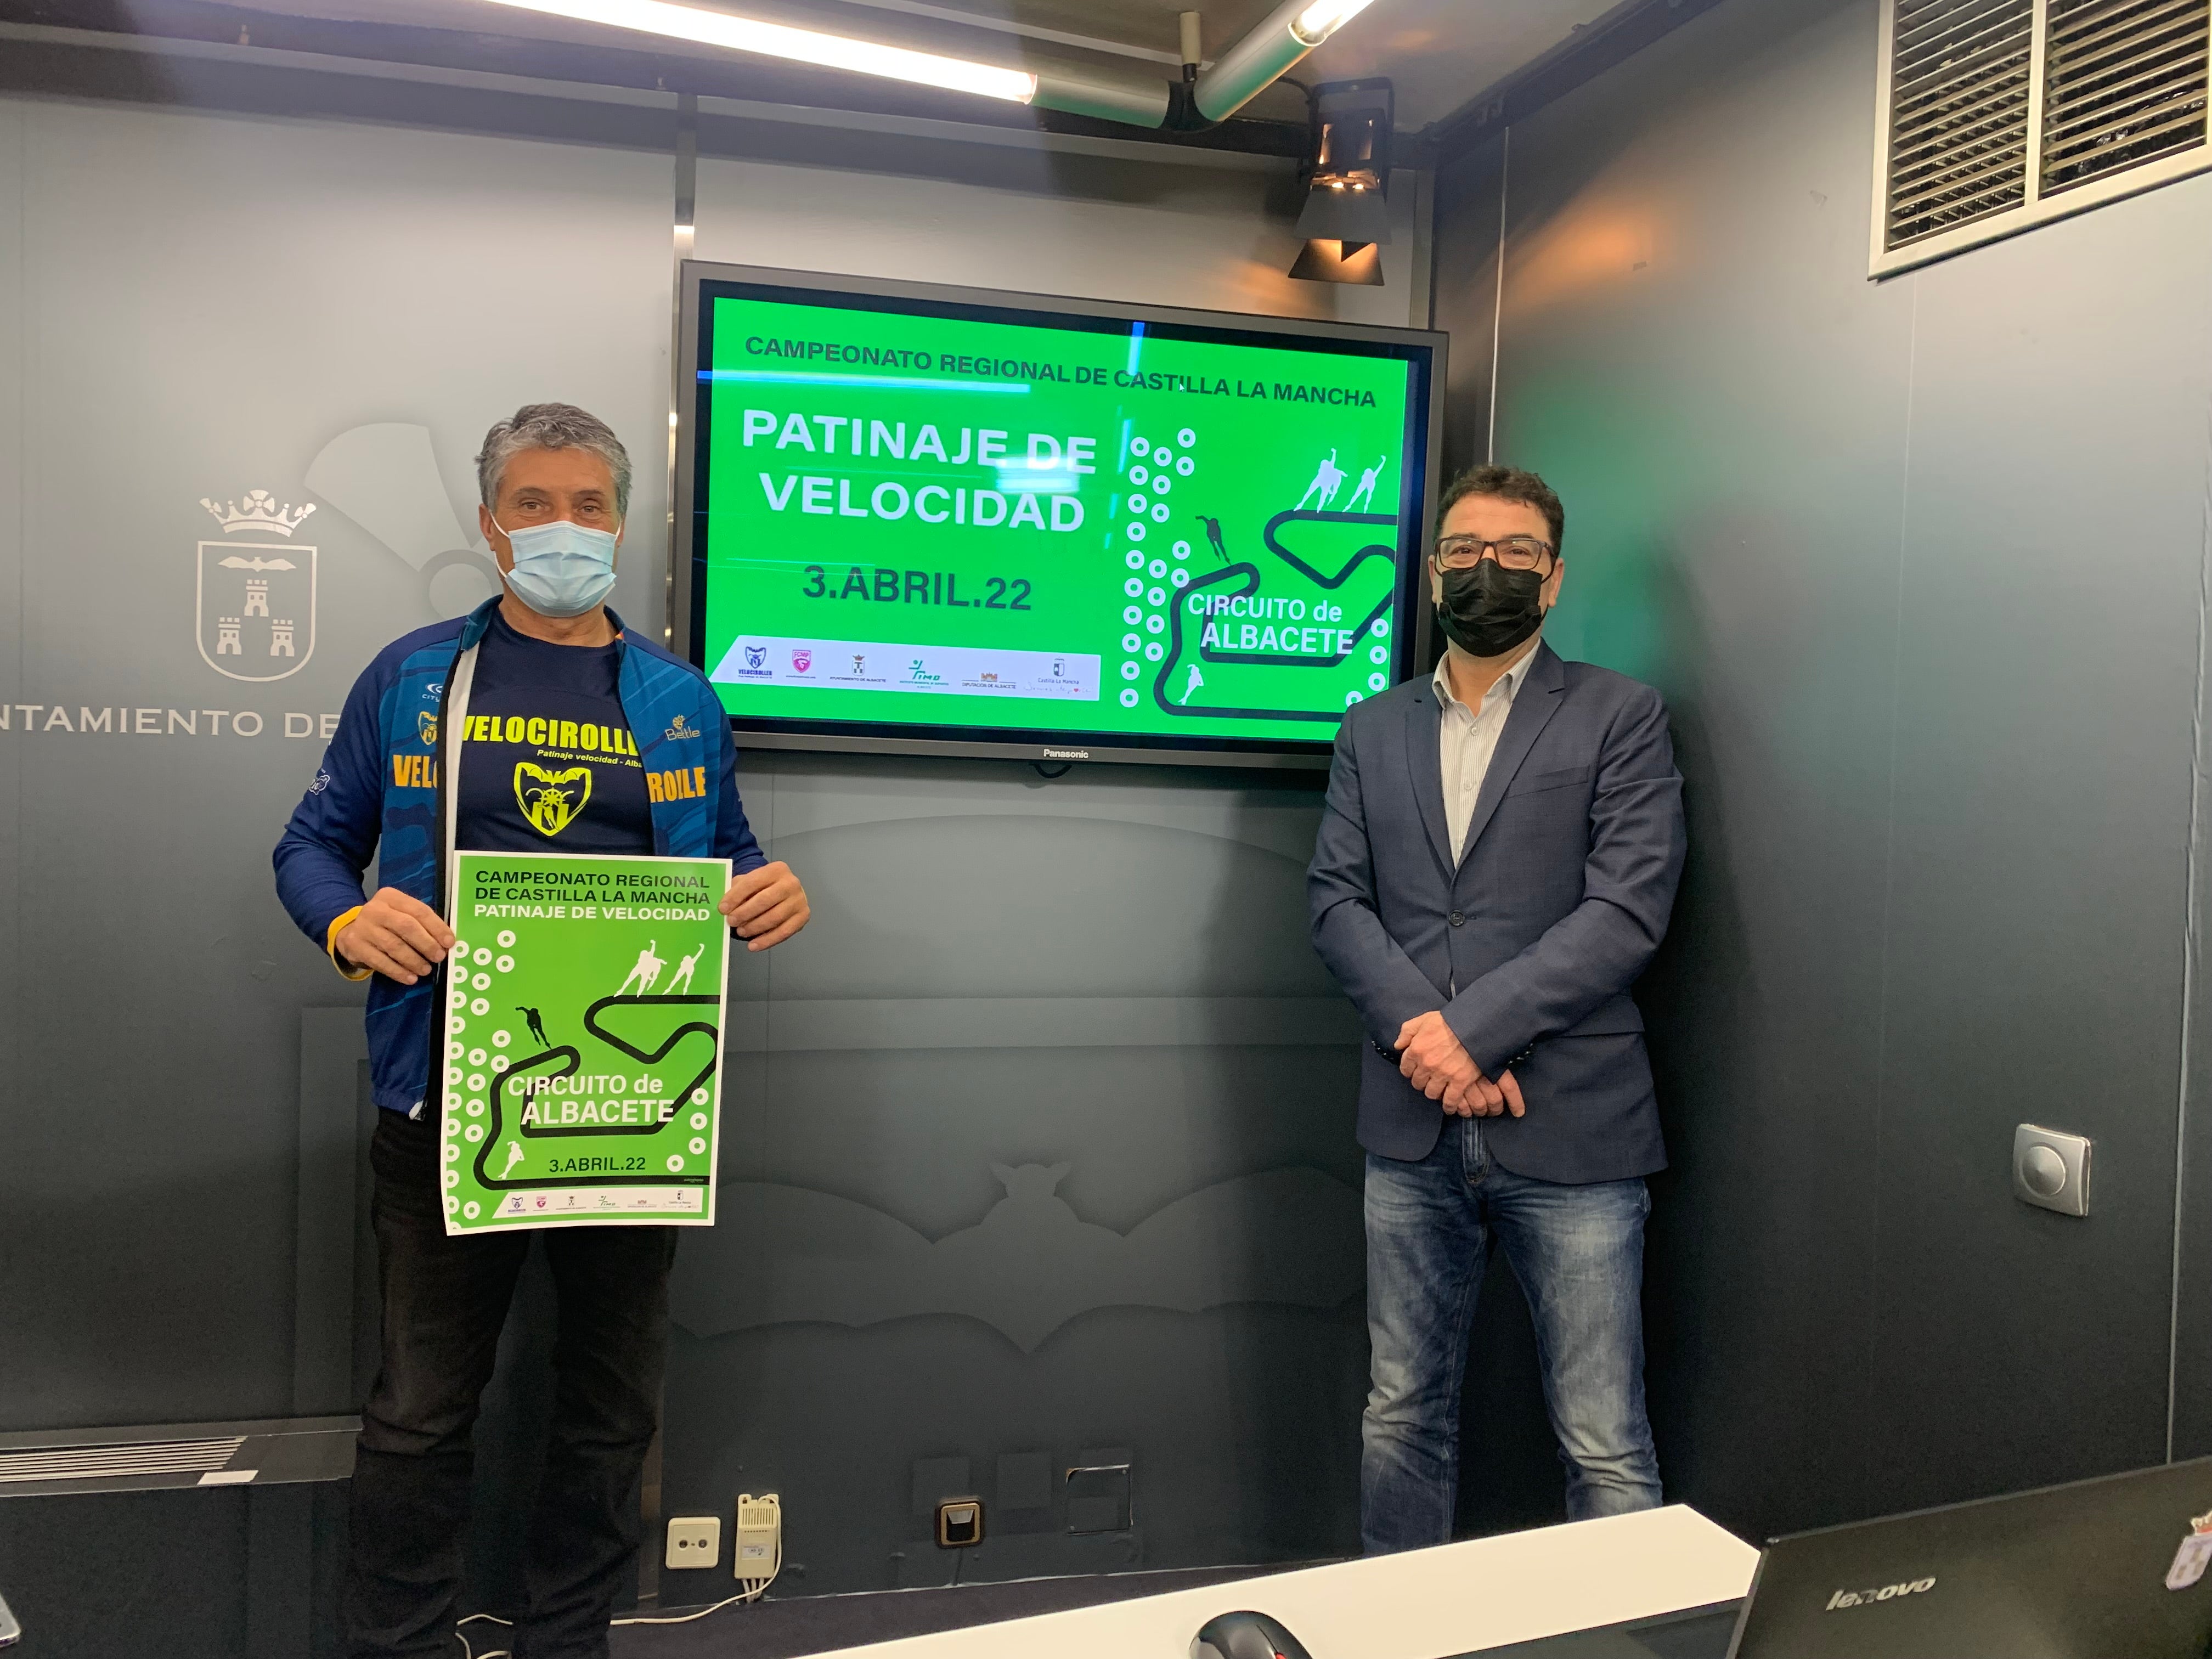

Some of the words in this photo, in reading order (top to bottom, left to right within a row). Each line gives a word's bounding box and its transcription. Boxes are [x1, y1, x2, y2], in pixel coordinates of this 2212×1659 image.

[746, 336, 932, 369] CAMPEONATO
[940, 354, 1070, 383] REGIONAL
[1075, 365, 1108, 386] DE
[1114, 369, 1230, 396] CASTILLA
[1237, 380, 1267, 399] LA
[1274, 383, 1377, 408] MANCHA
[743, 409, 1008, 467] PATINAJE
[1027, 432, 1097, 474] DE
[759, 472, 1085, 532] VELOCIDAD
[802, 565, 1031, 611] 3.ABRIL.22
[1188, 593, 1306, 620] CIRCUITO
[1313, 600, 1342, 622] de
[1200, 622, 1354, 654] ALBACETE
[537, 749, 573, 761] Patinaje
[576, 754, 618, 765] velocidad
[1043, 748, 1089, 759] Panasonic
[476, 870, 610, 887] CAMPEONATO
[616, 874, 710, 888] REGIONAL
[475, 888, 500, 900] DE
[505, 888, 597, 902] CASTILLA
[602, 890, 625, 902] LA
[630, 891, 710, 904] MANCHA
[474, 904, 566, 919] PATINAJE
[571, 906, 597, 919] DE
[602, 907, 710, 921] VELOCIDAD
[508, 1074, 627, 1097] CIRCUITO
[633, 1073, 663, 1094] de
[521, 1099, 674, 1125] ALBACETE
[549, 1156, 646, 1173] 3.ABRIL.22
[1826, 1577, 1936, 1611] lenovo
